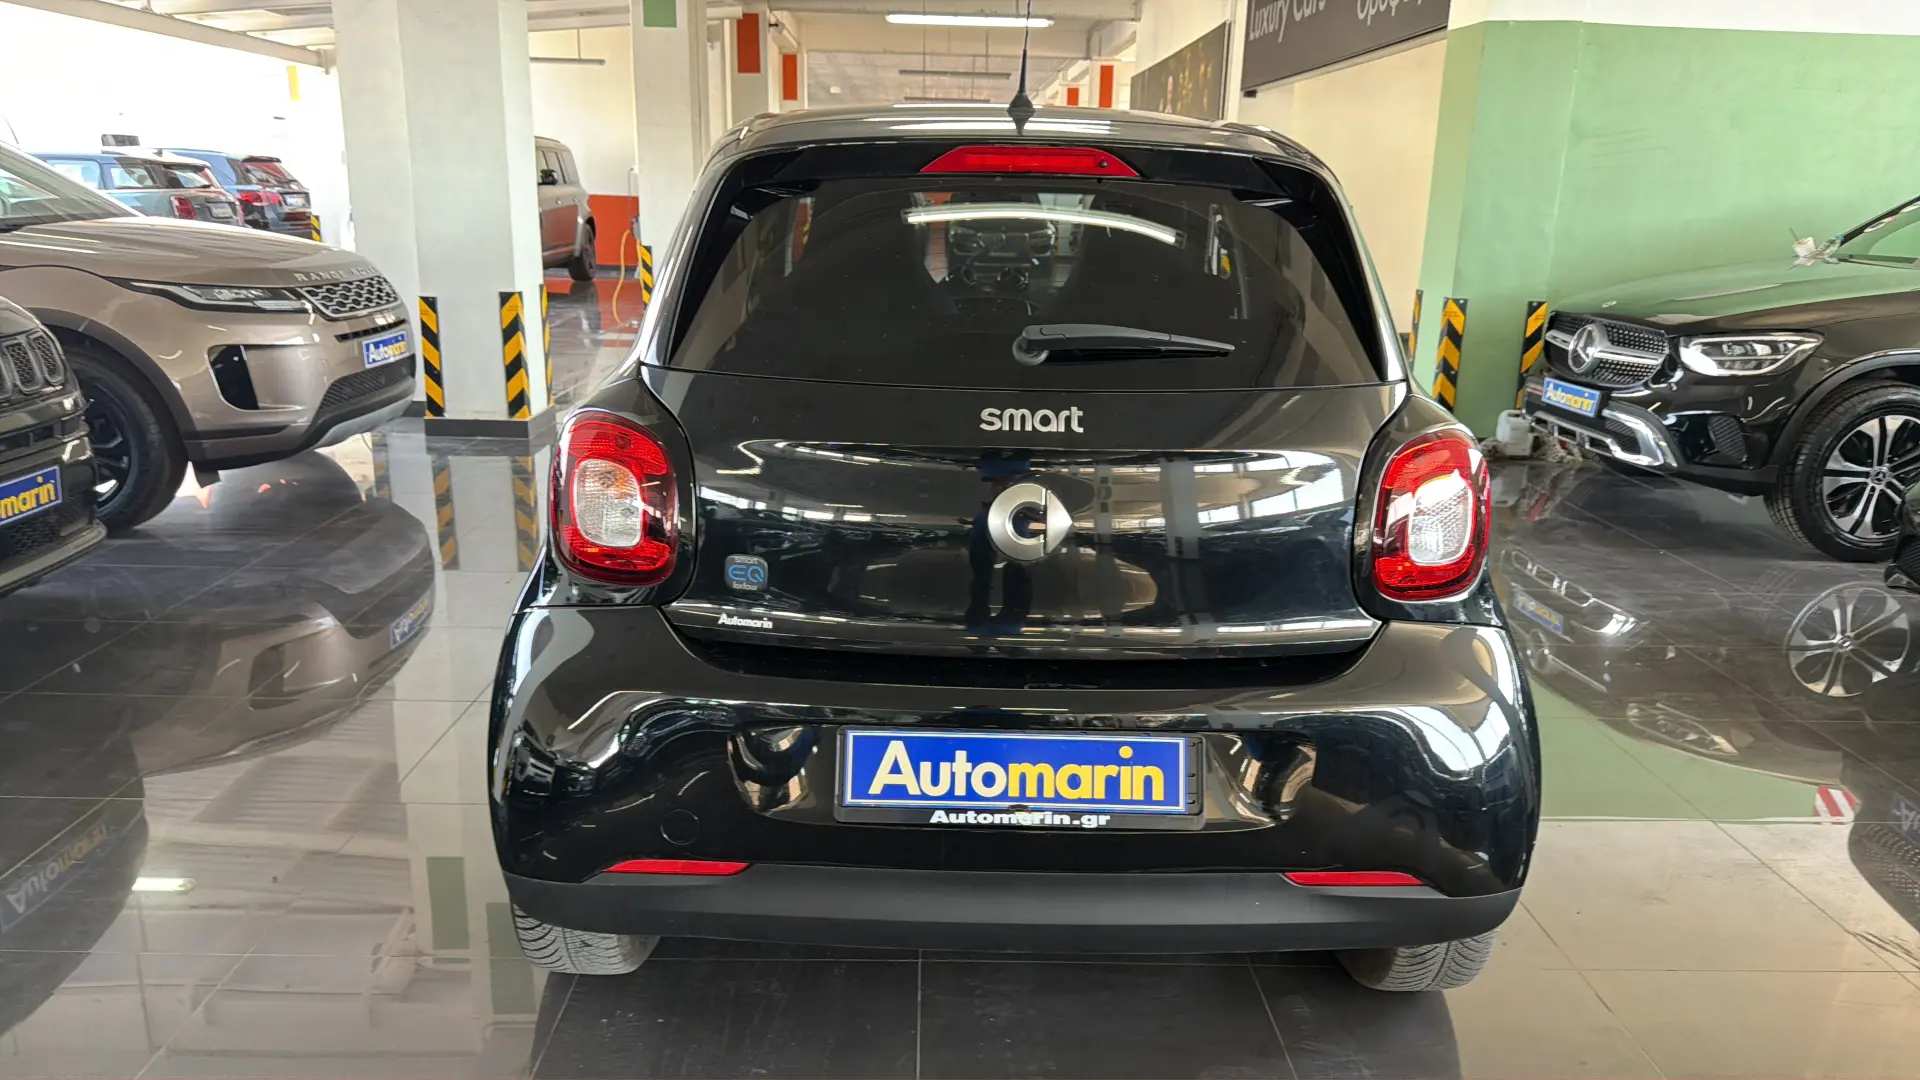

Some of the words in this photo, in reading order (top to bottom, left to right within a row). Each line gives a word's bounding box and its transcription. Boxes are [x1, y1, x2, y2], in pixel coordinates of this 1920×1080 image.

[1249, 0, 1289, 43] Luxury
[979, 406, 1084, 433] smart
[0, 476, 56, 518] marin
[728, 564, 764, 583] EQ
[718, 612, 773, 629] Automarin
[868, 740, 1165, 801] Automarin
[929, 810, 1111, 828] Automarin.gr
